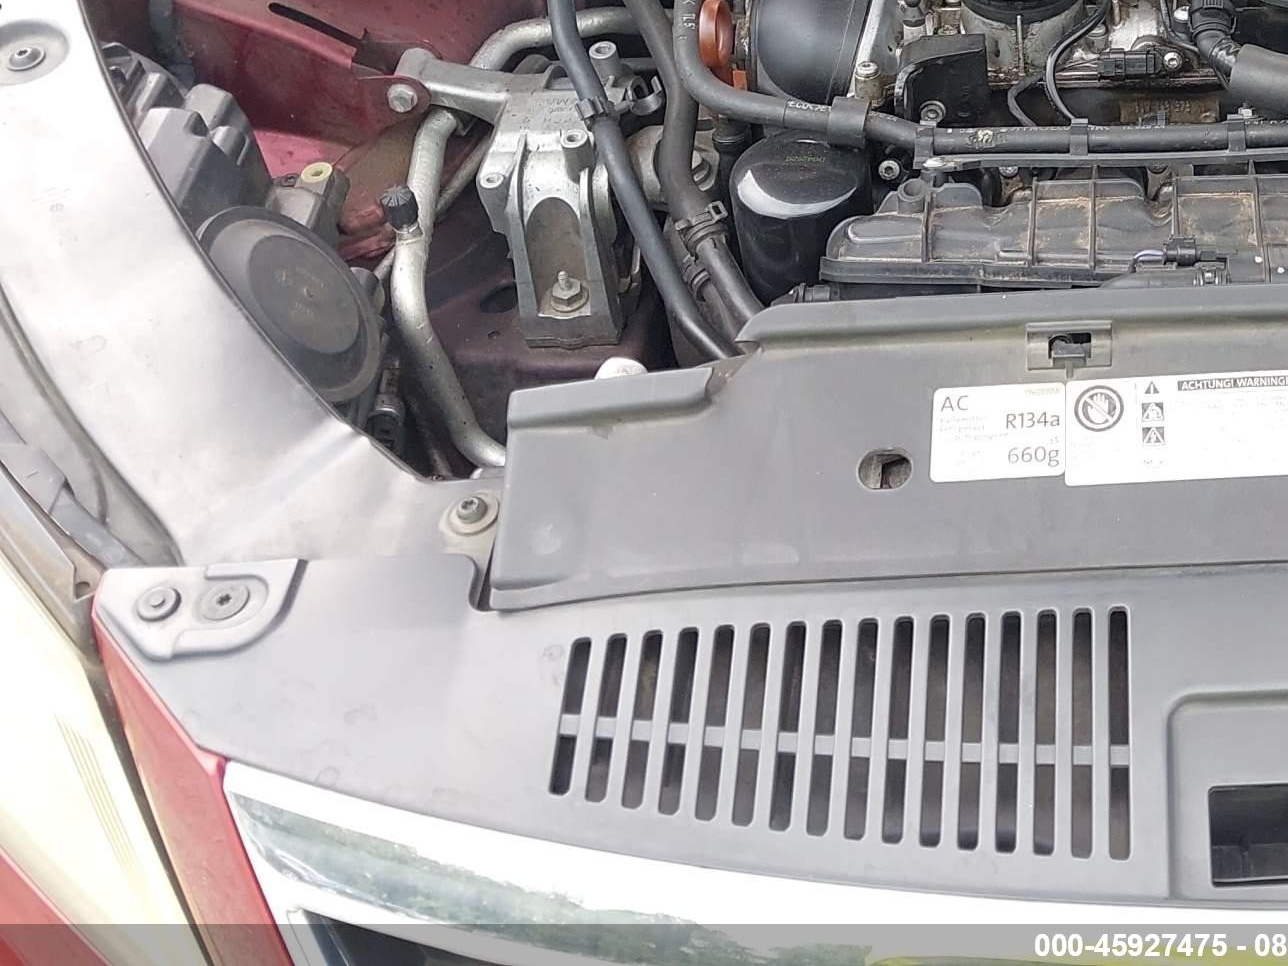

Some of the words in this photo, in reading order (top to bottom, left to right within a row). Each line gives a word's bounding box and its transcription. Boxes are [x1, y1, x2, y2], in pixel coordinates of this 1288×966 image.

[1182, 377, 1237, 390] ACHTUNG!
[1239, 375, 1288, 388] WARNING!
[940, 395, 969, 412] AC
[1006, 412, 1060, 429] R134a
[1008, 445, 1060, 467] 660g
